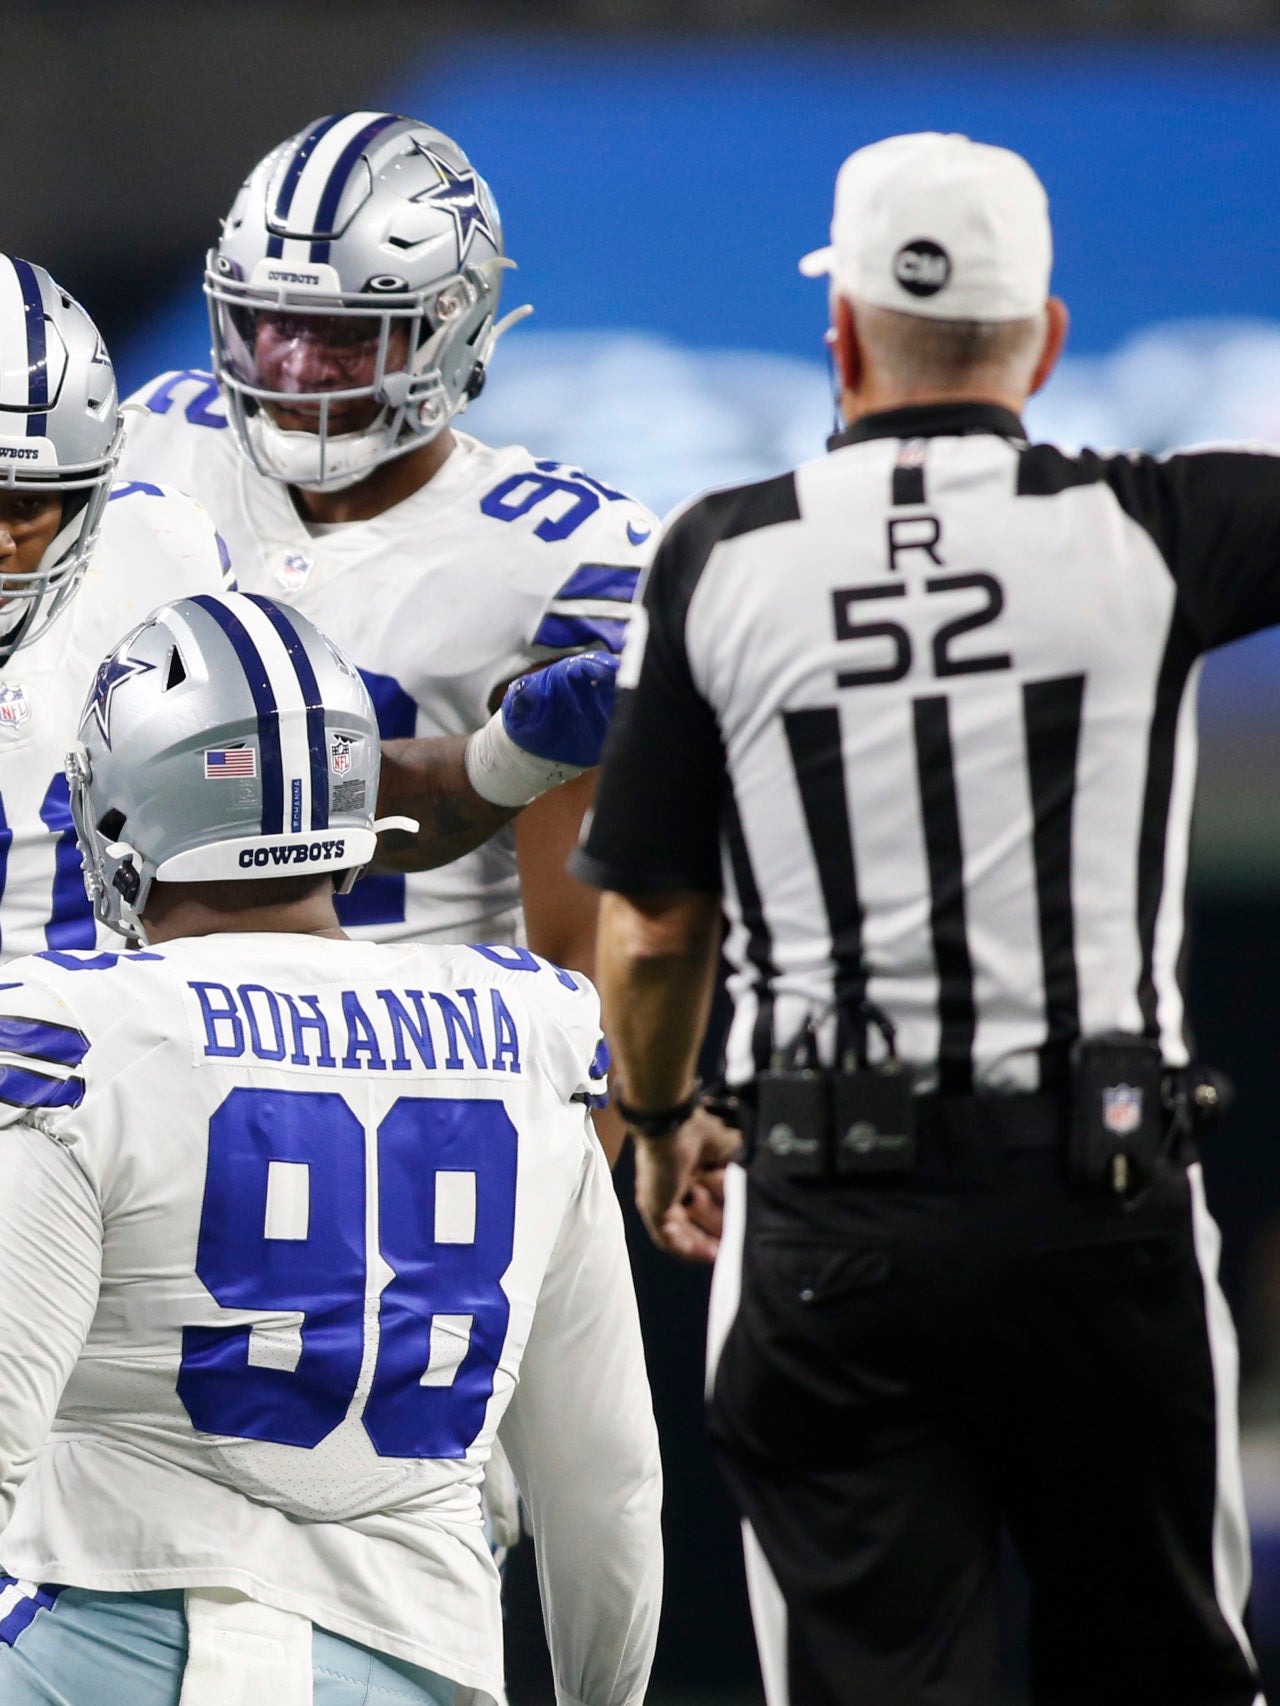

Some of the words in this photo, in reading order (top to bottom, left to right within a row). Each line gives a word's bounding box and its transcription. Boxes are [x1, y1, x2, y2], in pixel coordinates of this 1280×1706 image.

[888, 517, 943, 571] R
[832, 573, 1012, 690] 52
[239, 840, 345, 868] COWBOYS
[187, 981, 521, 1073] BOHANNA
[176, 1086, 518, 1458] 98
